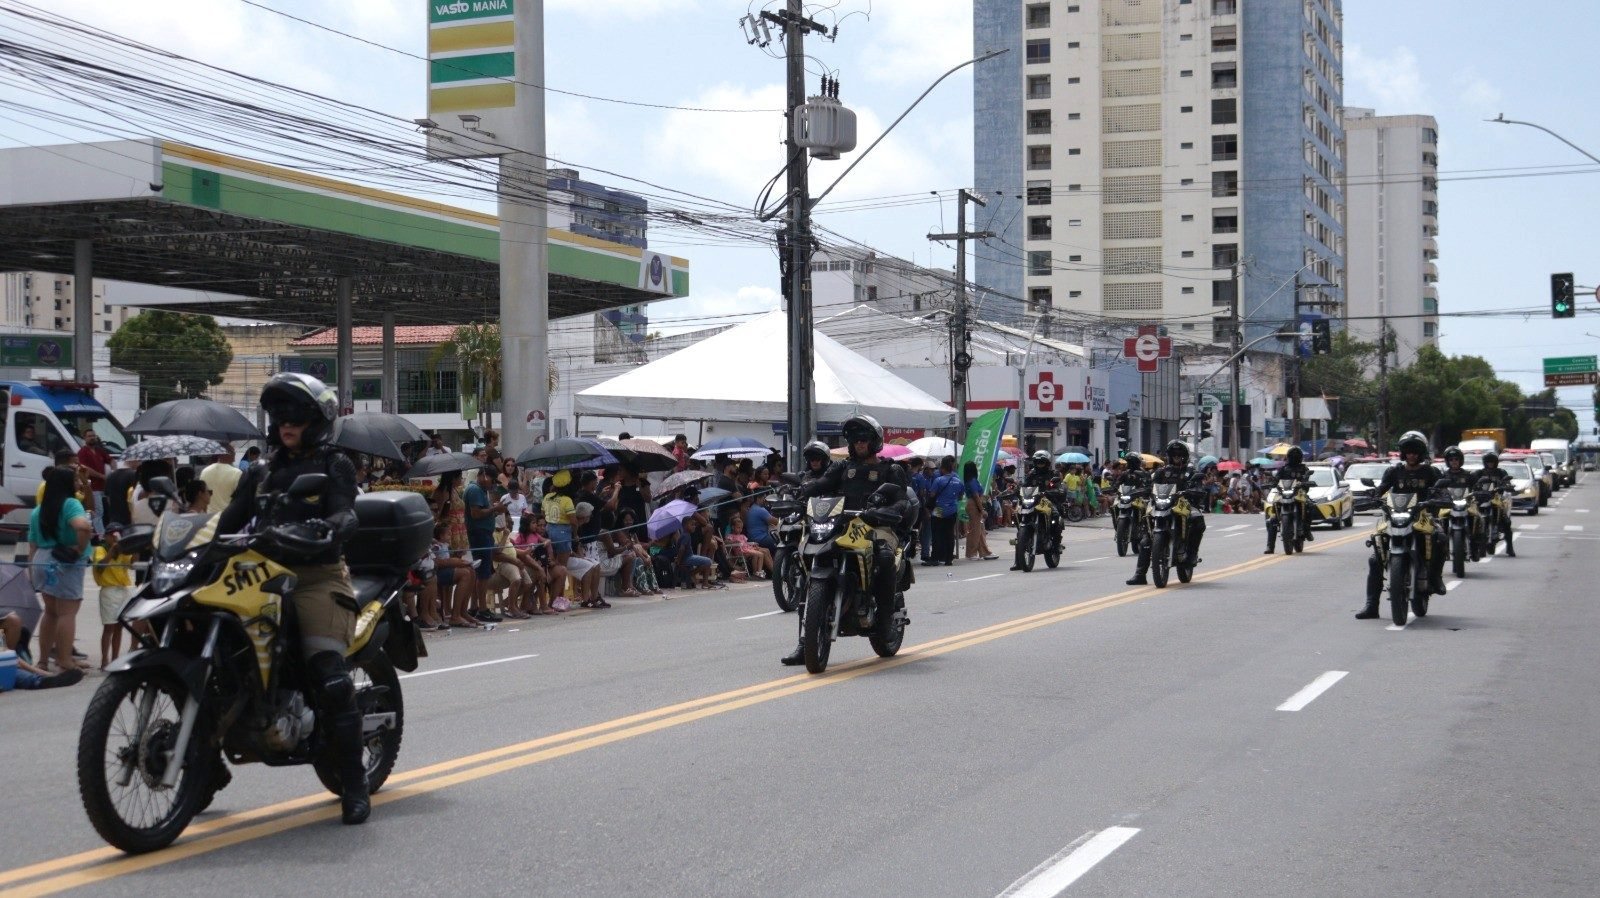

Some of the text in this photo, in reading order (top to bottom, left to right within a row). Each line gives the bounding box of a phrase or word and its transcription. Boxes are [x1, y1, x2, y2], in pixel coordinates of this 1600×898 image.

[473, 0, 508, 12] MANIA
[1037, 380, 1056, 404] e
[849, 524, 868, 544] SMTT
[223, 562, 271, 596] SMTT
